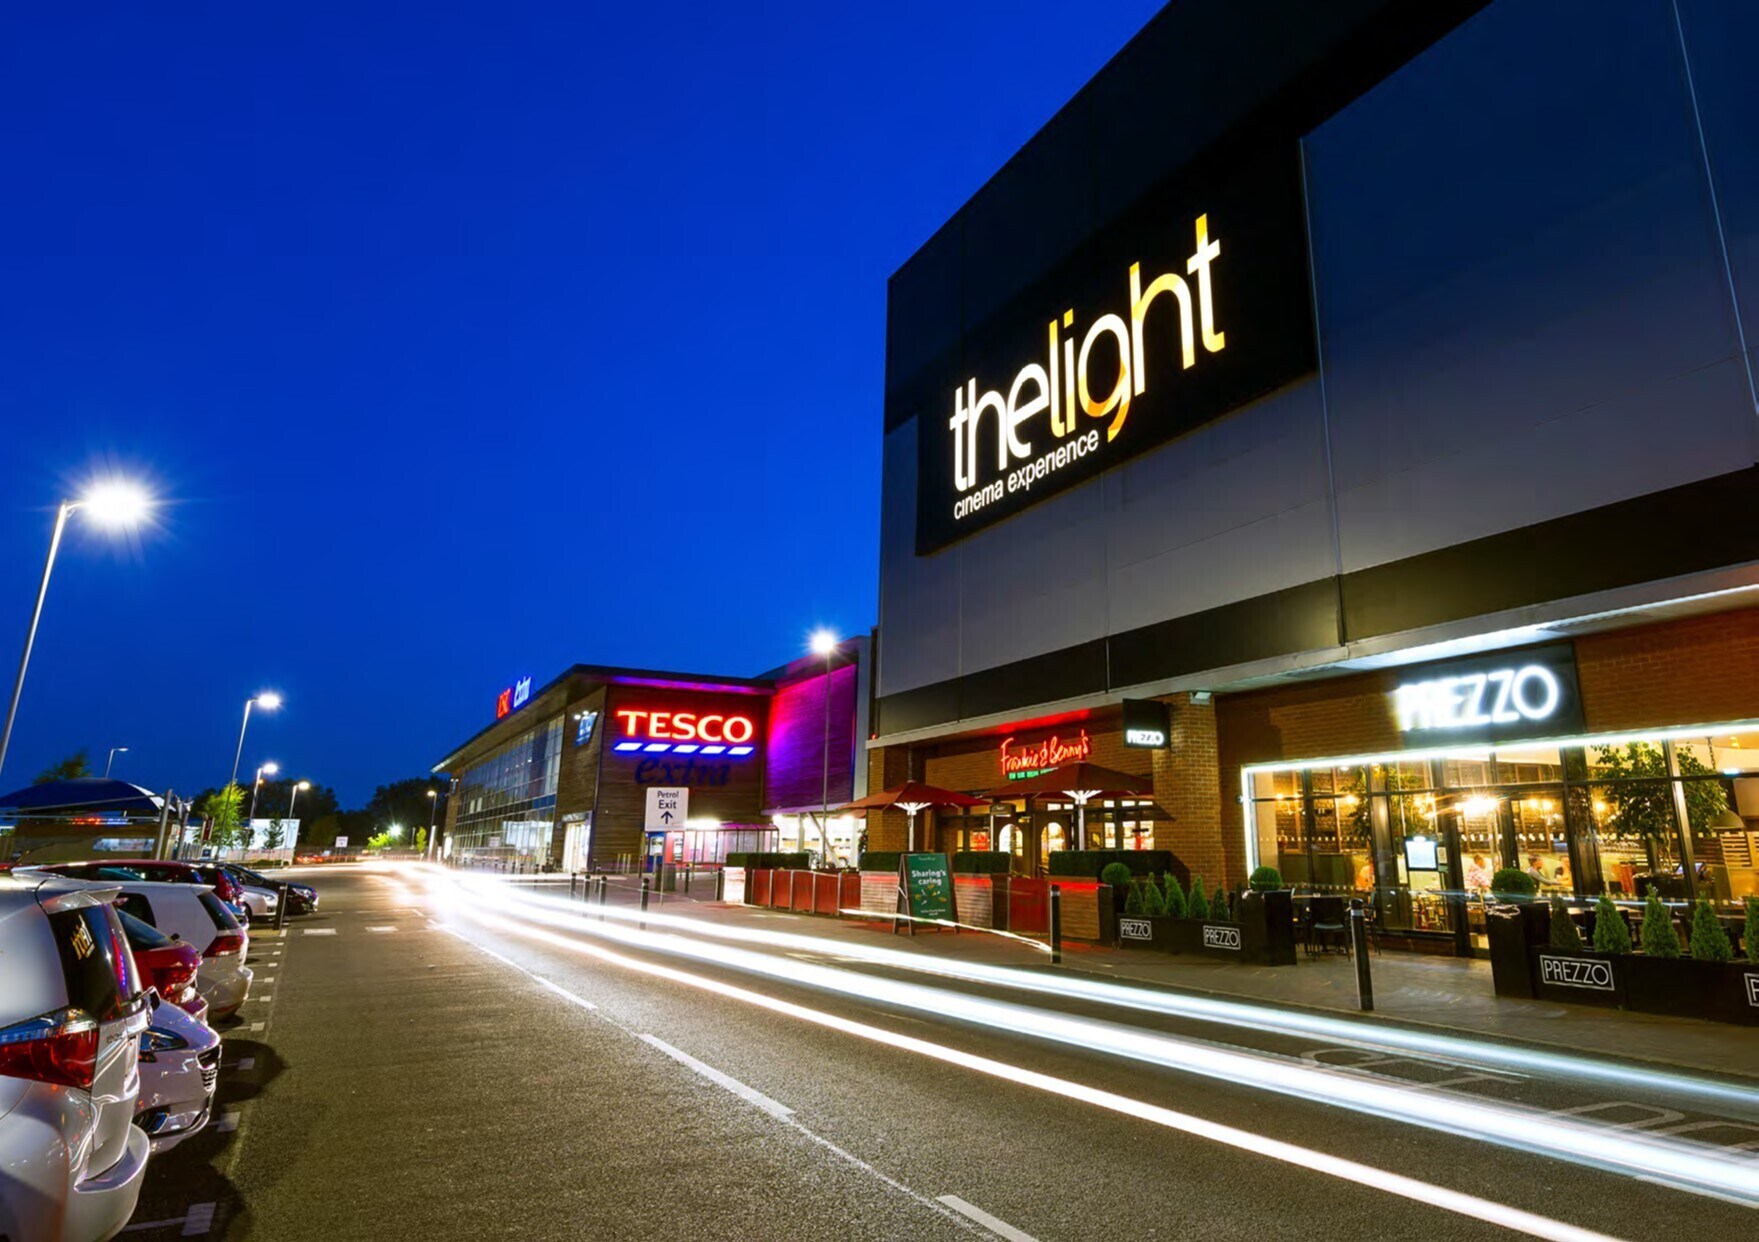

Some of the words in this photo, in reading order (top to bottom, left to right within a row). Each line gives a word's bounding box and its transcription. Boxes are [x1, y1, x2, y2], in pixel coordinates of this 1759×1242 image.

[954, 479, 1003, 520] cinema
[1007, 429, 1099, 491] experience
[617, 710, 753, 743] TESCO
[635, 756, 731, 786] extra
[657, 790, 679, 798] Petrol
[658, 800, 677, 809] Exit
[911, 869, 947, 878] Sharing's
[918, 877, 942, 886] caring
[1121, 922, 1150, 937] PREZZO
[1205, 929, 1239, 946] PREZZO
[1544, 960, 1609, 985] PREZZO
